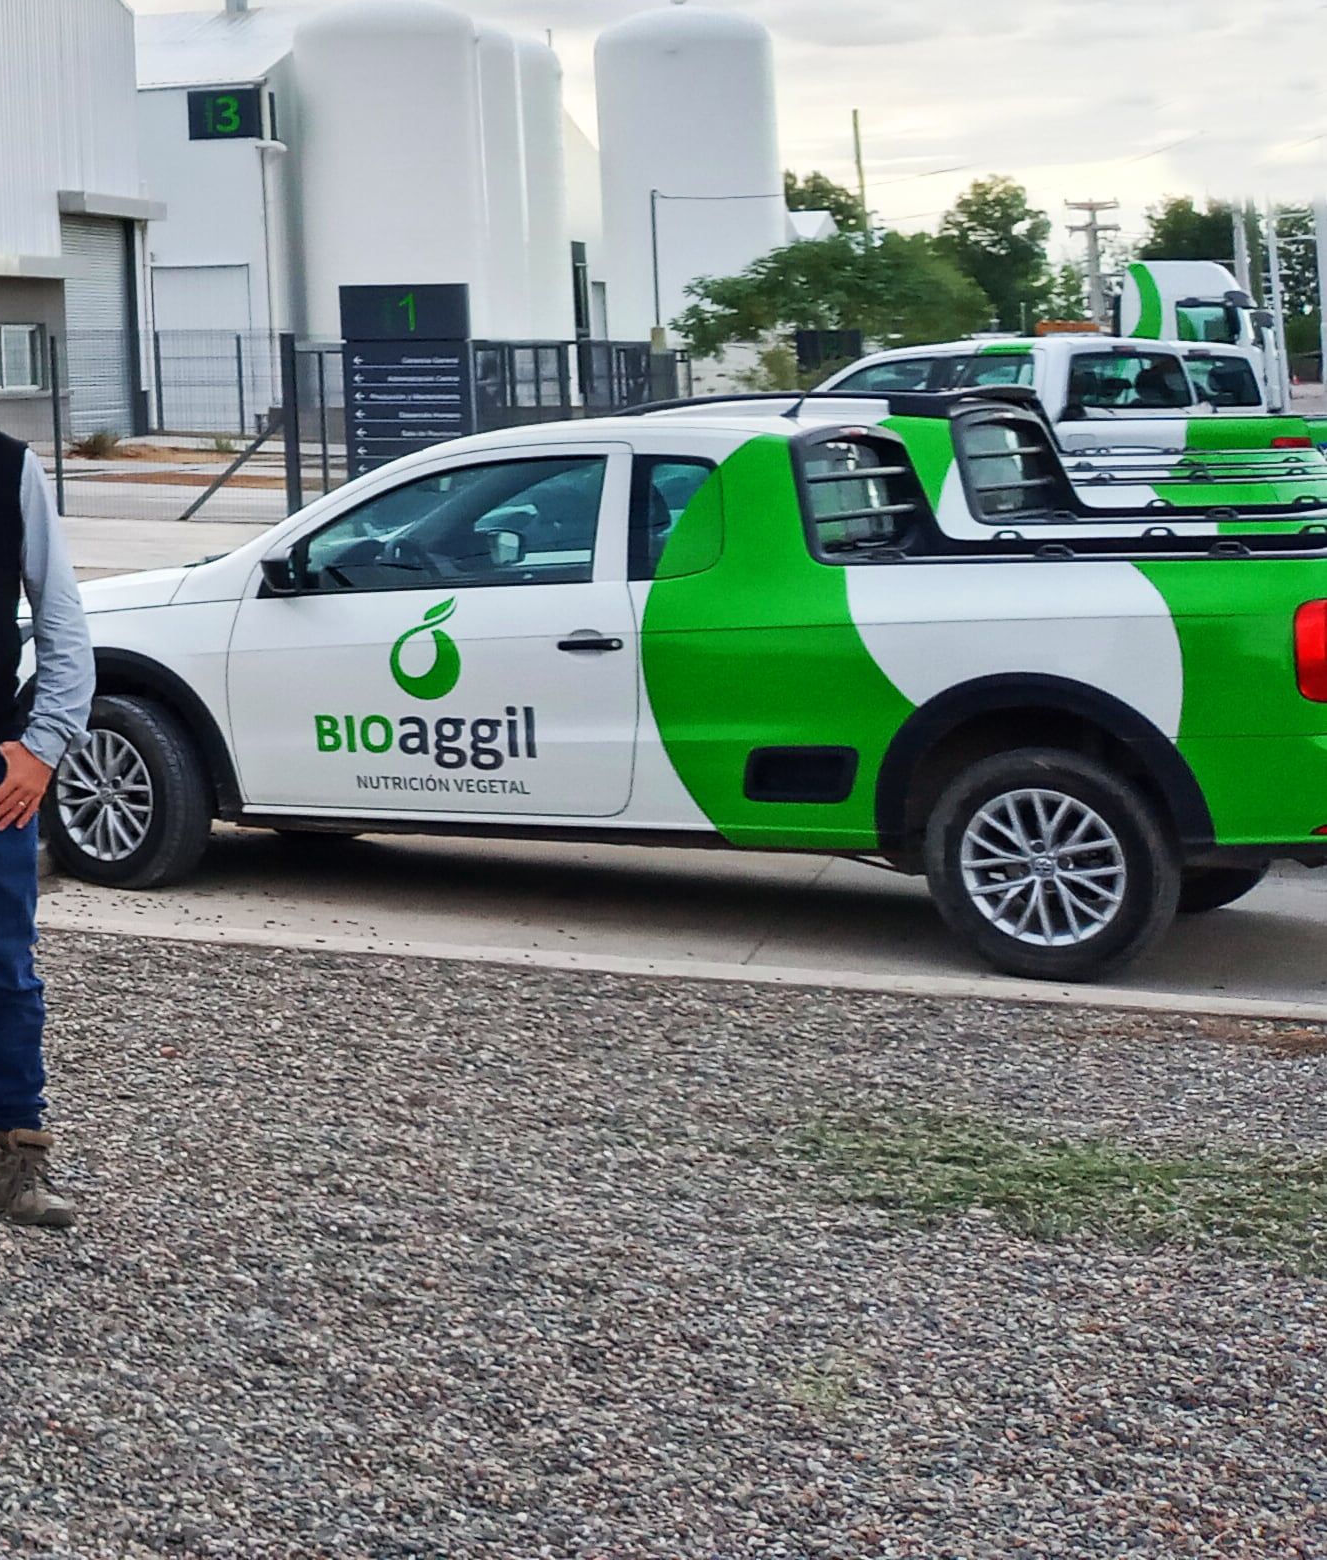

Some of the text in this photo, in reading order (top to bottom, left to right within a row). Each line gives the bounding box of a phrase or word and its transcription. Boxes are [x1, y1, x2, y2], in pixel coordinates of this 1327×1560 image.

[215, 95, 241, 133] 3
[398, 292, 416, 333] 1
[314, 705, 538, 771] BIOaggil
[356, 774, 531, 795] NUTRICIÓN VEGETAL
